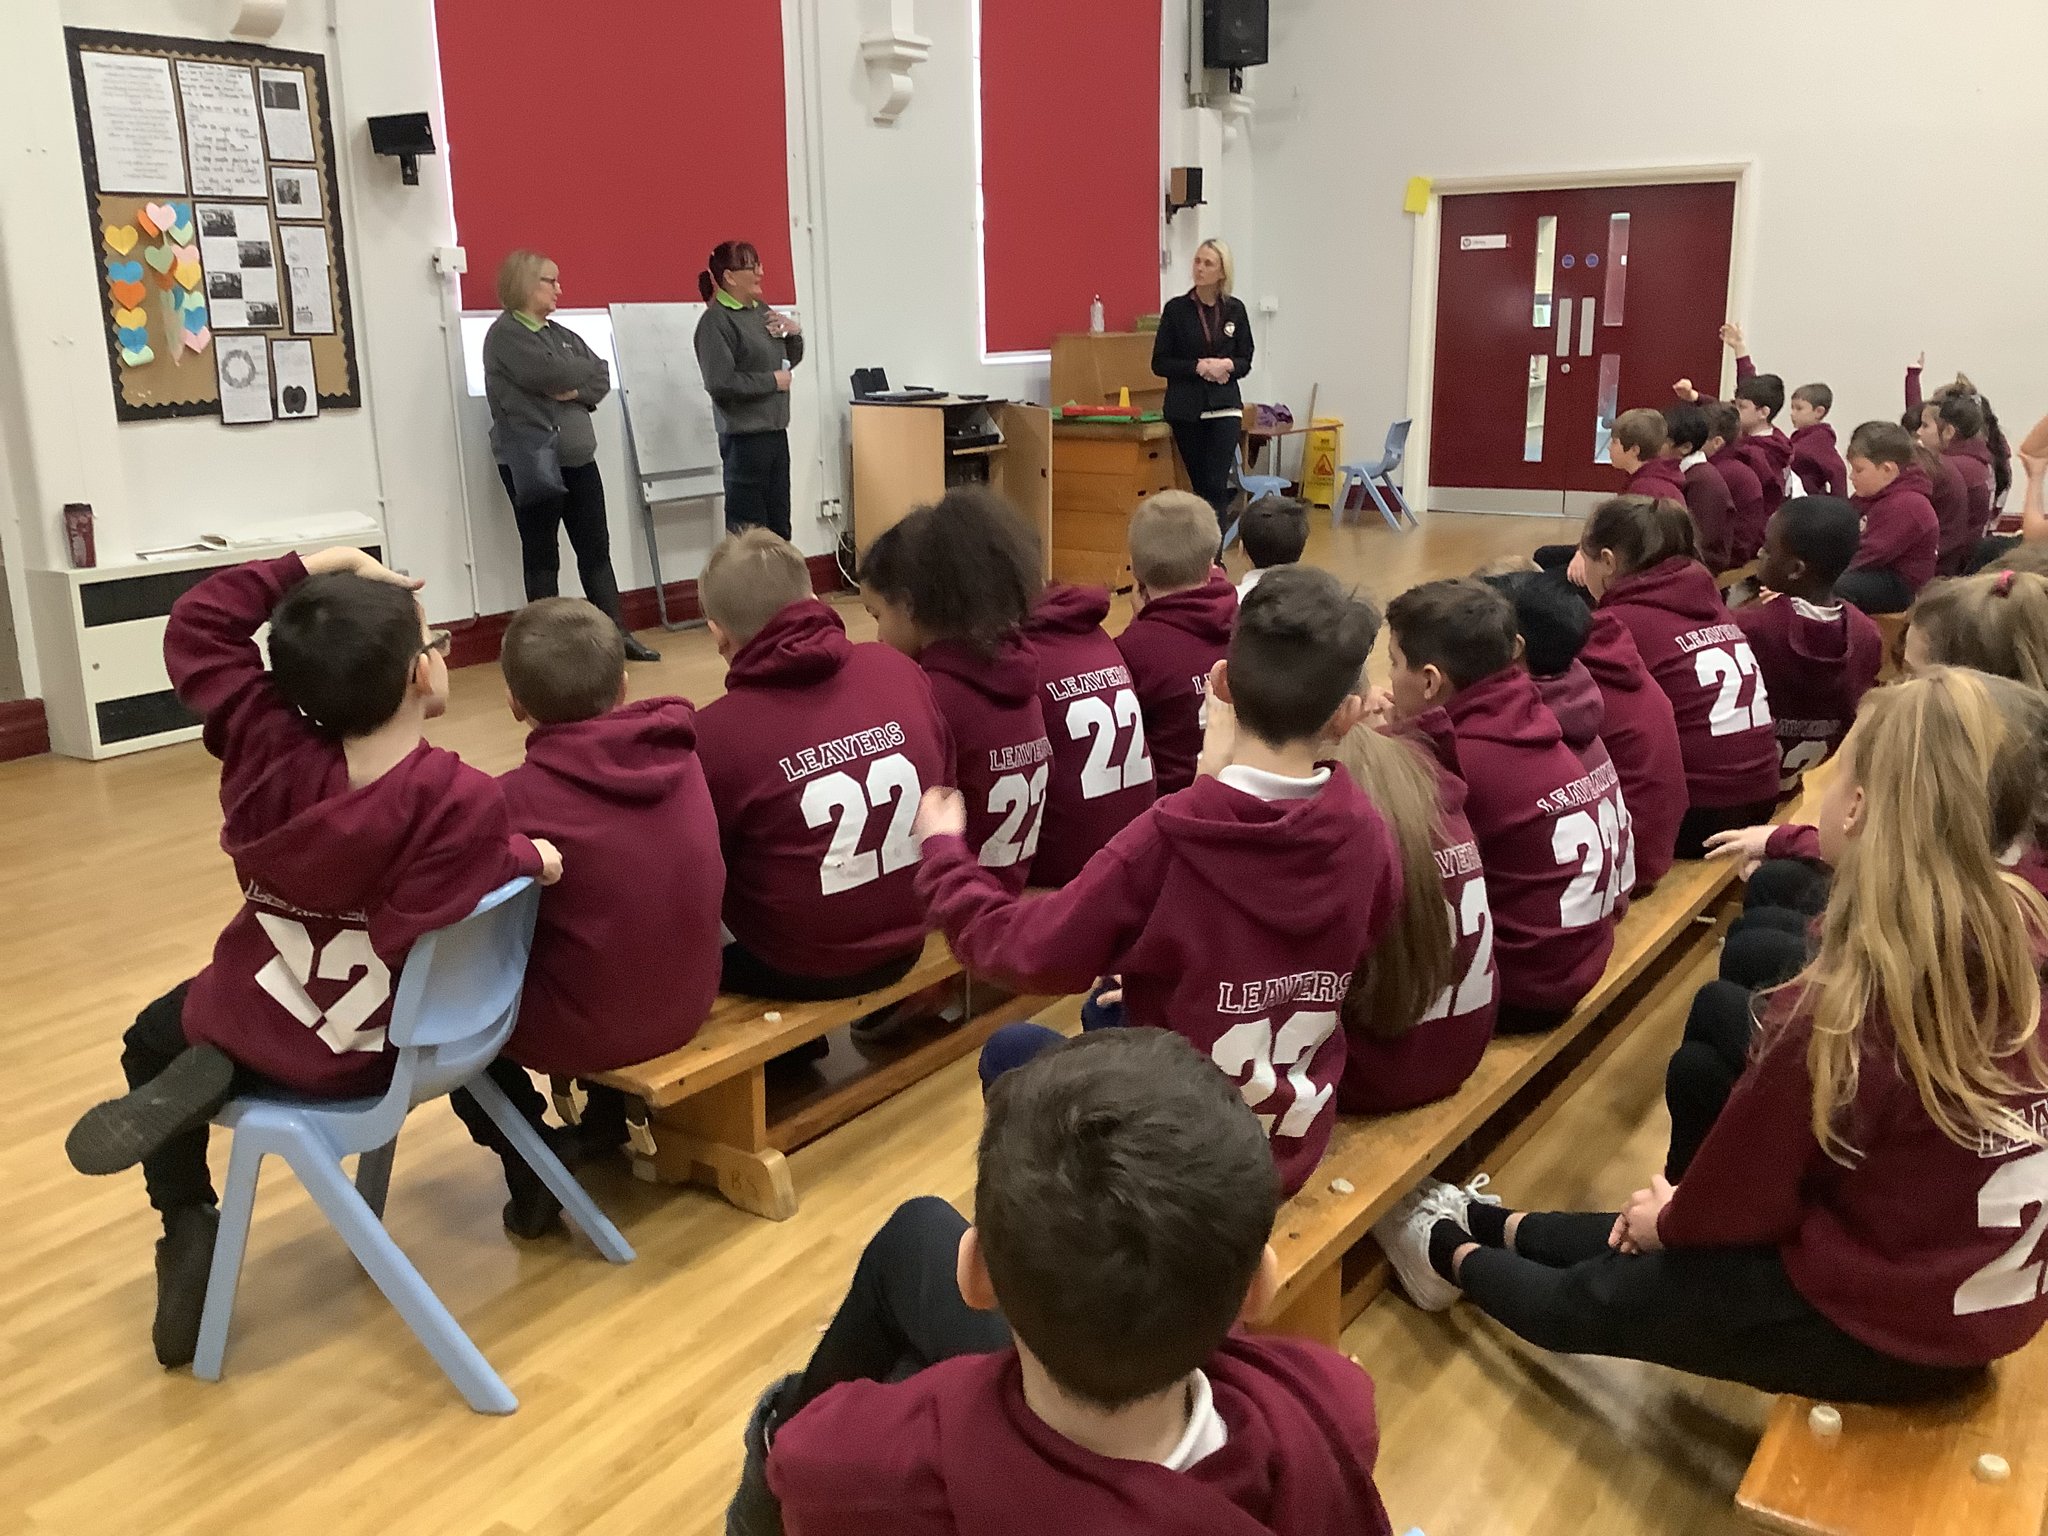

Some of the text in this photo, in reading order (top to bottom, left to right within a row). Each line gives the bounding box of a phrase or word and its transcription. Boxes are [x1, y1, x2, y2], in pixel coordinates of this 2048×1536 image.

[1694, 643, 1773, 737] 22
[779, 721, 906, 782] LEAVERS
[1065, 688, 1153, 800] 22
[800, 752, 923, 896] 22
[978, 762, 1049, 867] 22
[1217, 970, 1353, 1015] LEAVERS
[1211, 1010, 1338, 1139] 22
